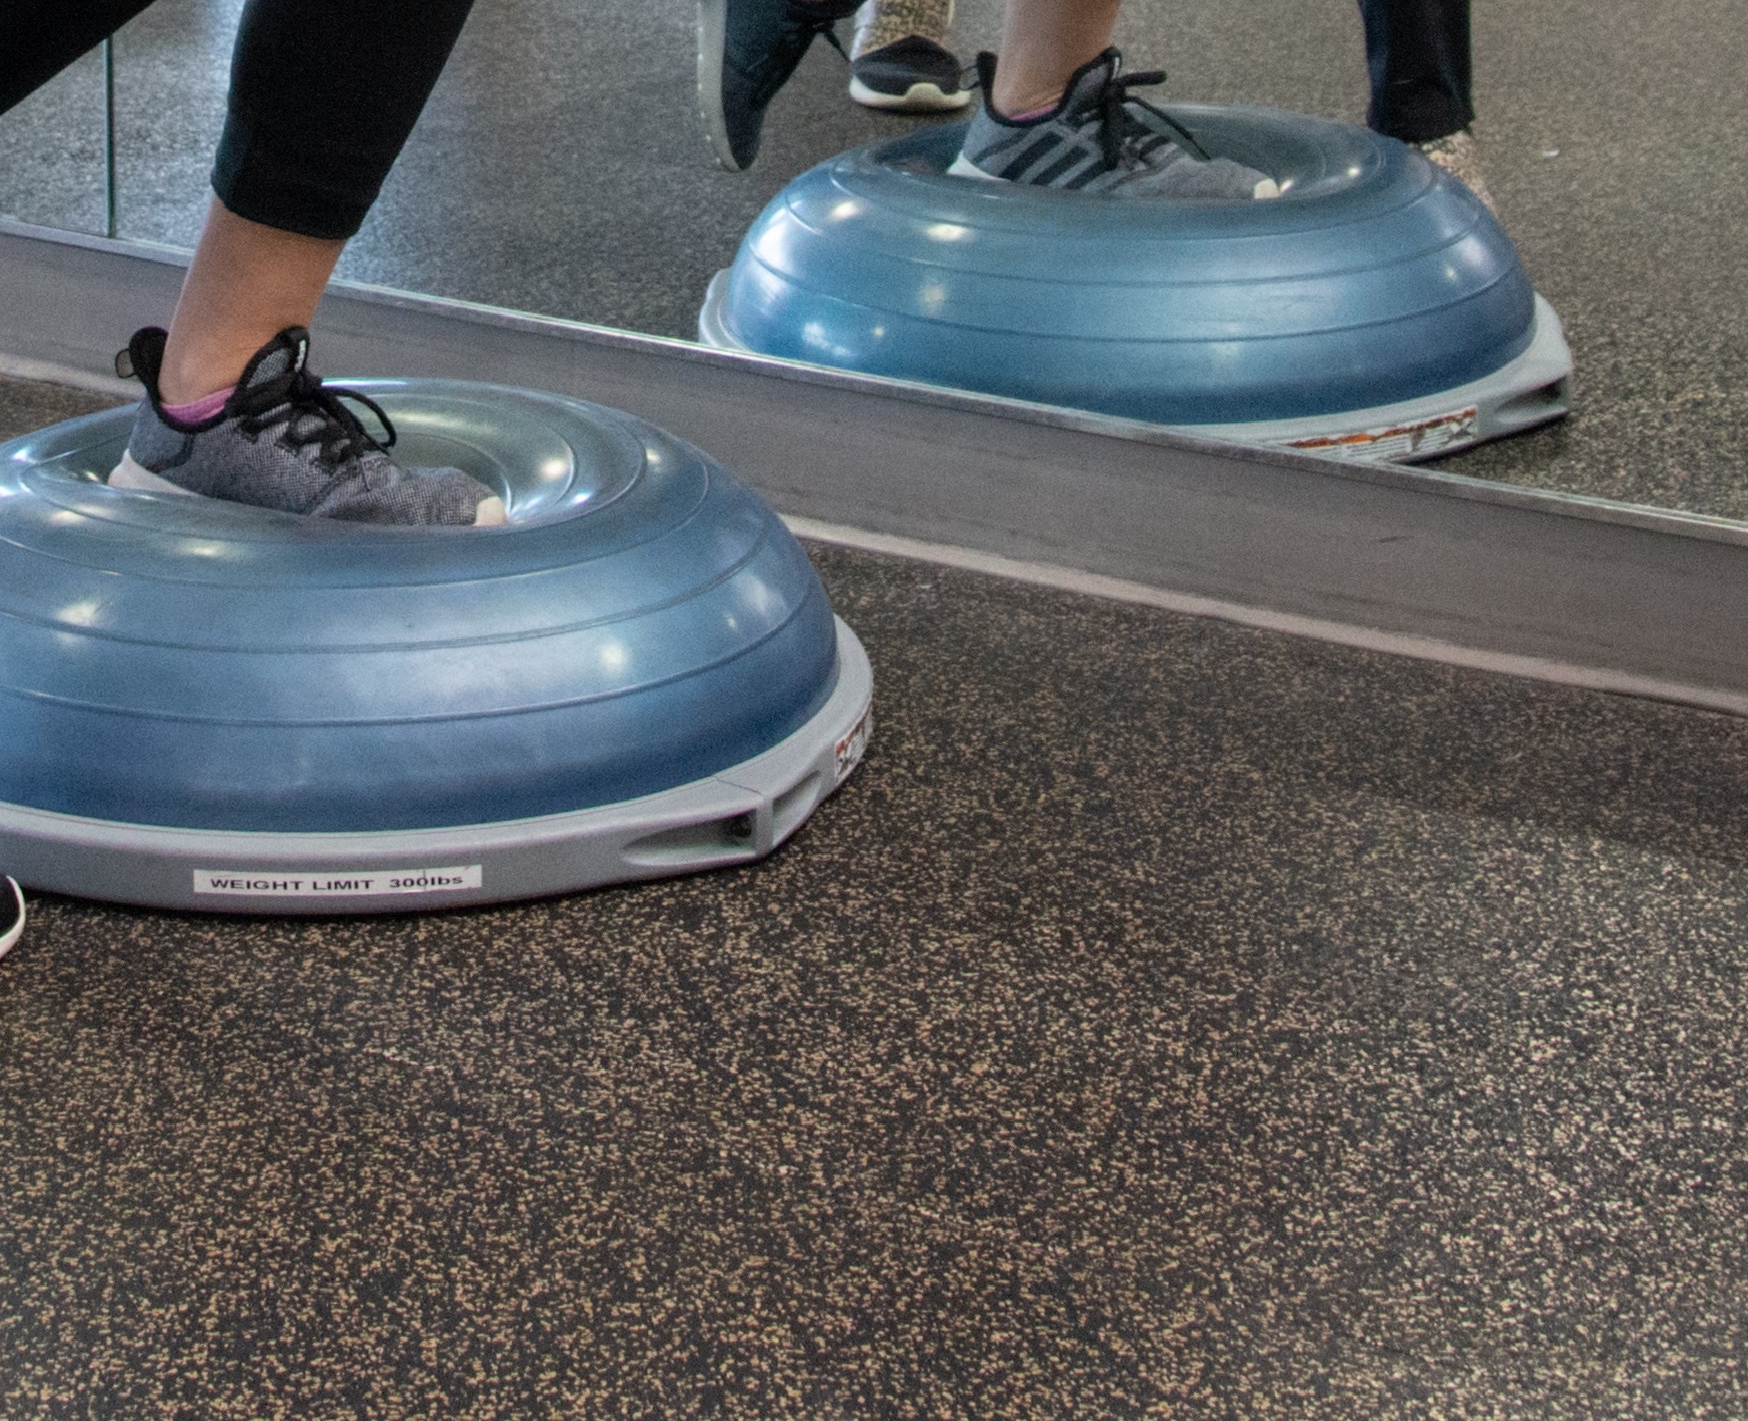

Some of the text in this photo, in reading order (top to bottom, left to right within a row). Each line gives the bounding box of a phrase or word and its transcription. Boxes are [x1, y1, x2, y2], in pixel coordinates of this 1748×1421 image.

[209, 874, 464, 891] WEIGHT LIMIT 300lbs
